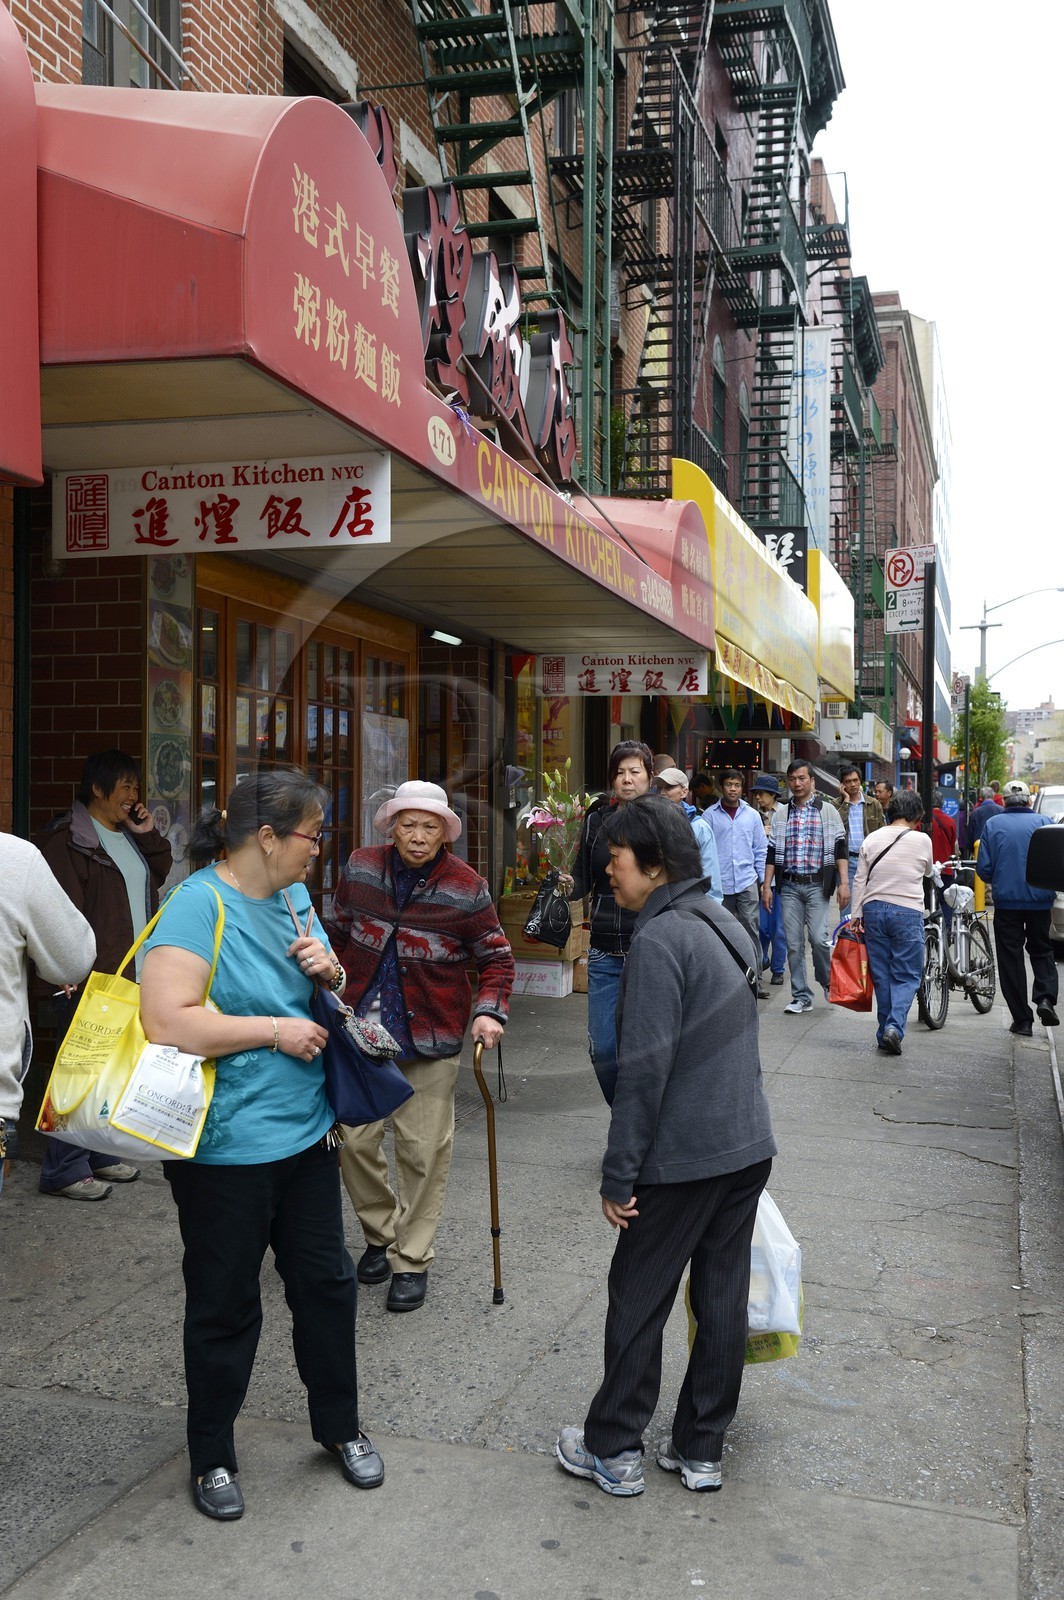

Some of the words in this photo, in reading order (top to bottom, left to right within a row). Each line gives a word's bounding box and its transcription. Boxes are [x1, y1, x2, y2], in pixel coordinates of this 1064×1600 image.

[292, 162, 400, 319] 港式早餐
[293, 271, 401, 408] 粥粉麵飯
[431, 424, 453, 460] 171
[141, 470, 225, 492] Canton
[231, 463, 325, 487] Kitchen
[331, 465, 364, 481] NYC
[131, 486, 375, 547] 進煌飯店
[477, 440, 555, 546] CANTON
[564, 508, 622, 590] KITCHEN
[887, 592, 896, 609] 2
[889, 609, 908, 619] EXCEPT
[910, 608, 924, 616] SUND
[581, 655, 624, 666] Canton
[627, 655, 675, 665] Kitchen
[677, 657, 695, 665] NYC
[577, 667, 700, 693] 進煌飯店
[78, 1019, 112, 1036] NCORD
[138, 1083, 182, 1110] CONCORD
